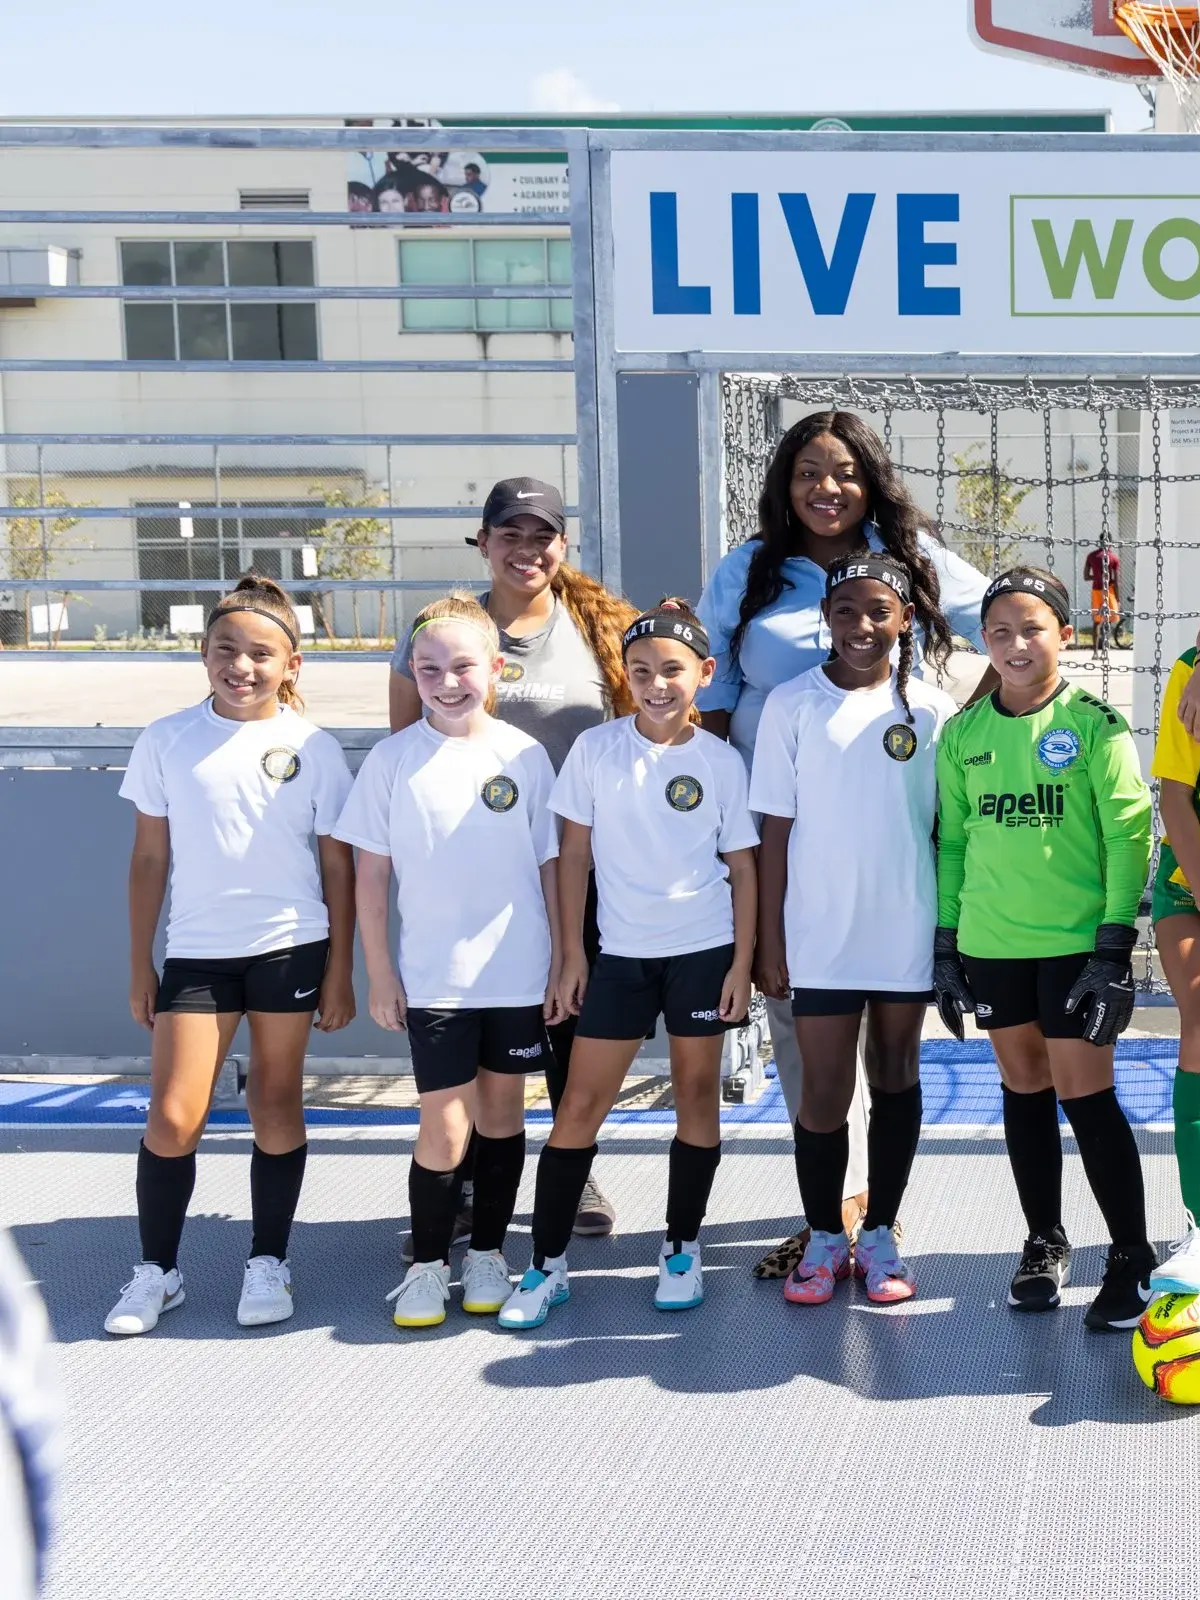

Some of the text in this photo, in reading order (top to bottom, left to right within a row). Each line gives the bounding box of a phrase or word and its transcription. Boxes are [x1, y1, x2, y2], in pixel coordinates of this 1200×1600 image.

[519, 176, 559, 184] CULINARY
[521, 191, 559, 199] ACADEMY
[650, 192, 961, 316] LIVE
[1022, 577, 1046, 592] #5
[623, 619, 693, 646] NATI #6
[496, 682, 565, 700] PRIME
[964, 751, 992, 766] capelli
[1005, 816, 1064, 828] SPORT
[691, 1009, 719, 1021] cape
[1089, 1001, 1106, 1040] reusch
[508, 1042, 541, 1058] capelli
